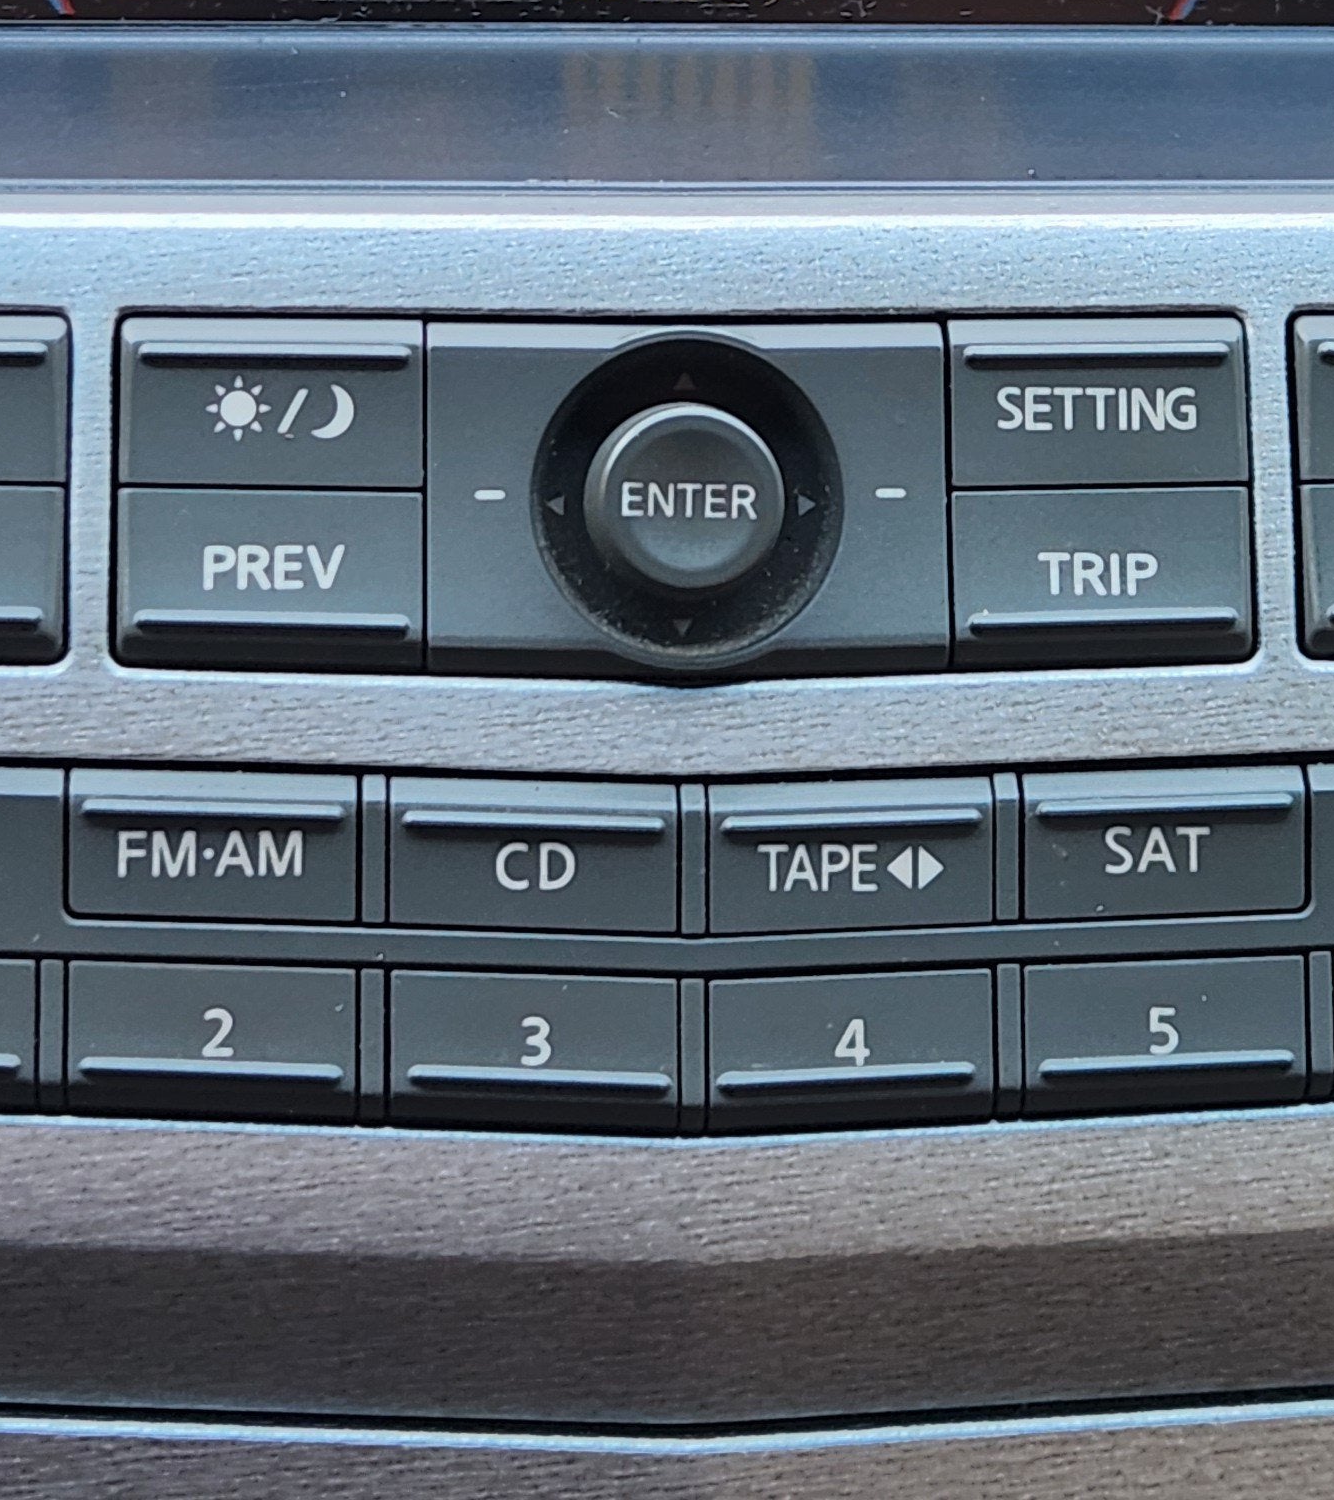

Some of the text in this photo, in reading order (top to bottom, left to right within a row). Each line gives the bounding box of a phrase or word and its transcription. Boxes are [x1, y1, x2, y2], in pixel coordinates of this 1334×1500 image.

[995, 386, 1199, 433] SETTING
[619, 481, 758, 522] ENTER
[202, 544, 346, 591] PREV
[1037, 552, 1159, 596] TRIP
[493, 844, 576, 892] CD
[758, 843, 878, 893] TAPE
[1103, 825, 1211, 876] SAT
[202, 1008, 235, 1058] 2
[519, 1016, 553, 1066] 3
[834, 1018, 871, 1068] 4
[1148, 1005, 1180, 1055] 5
